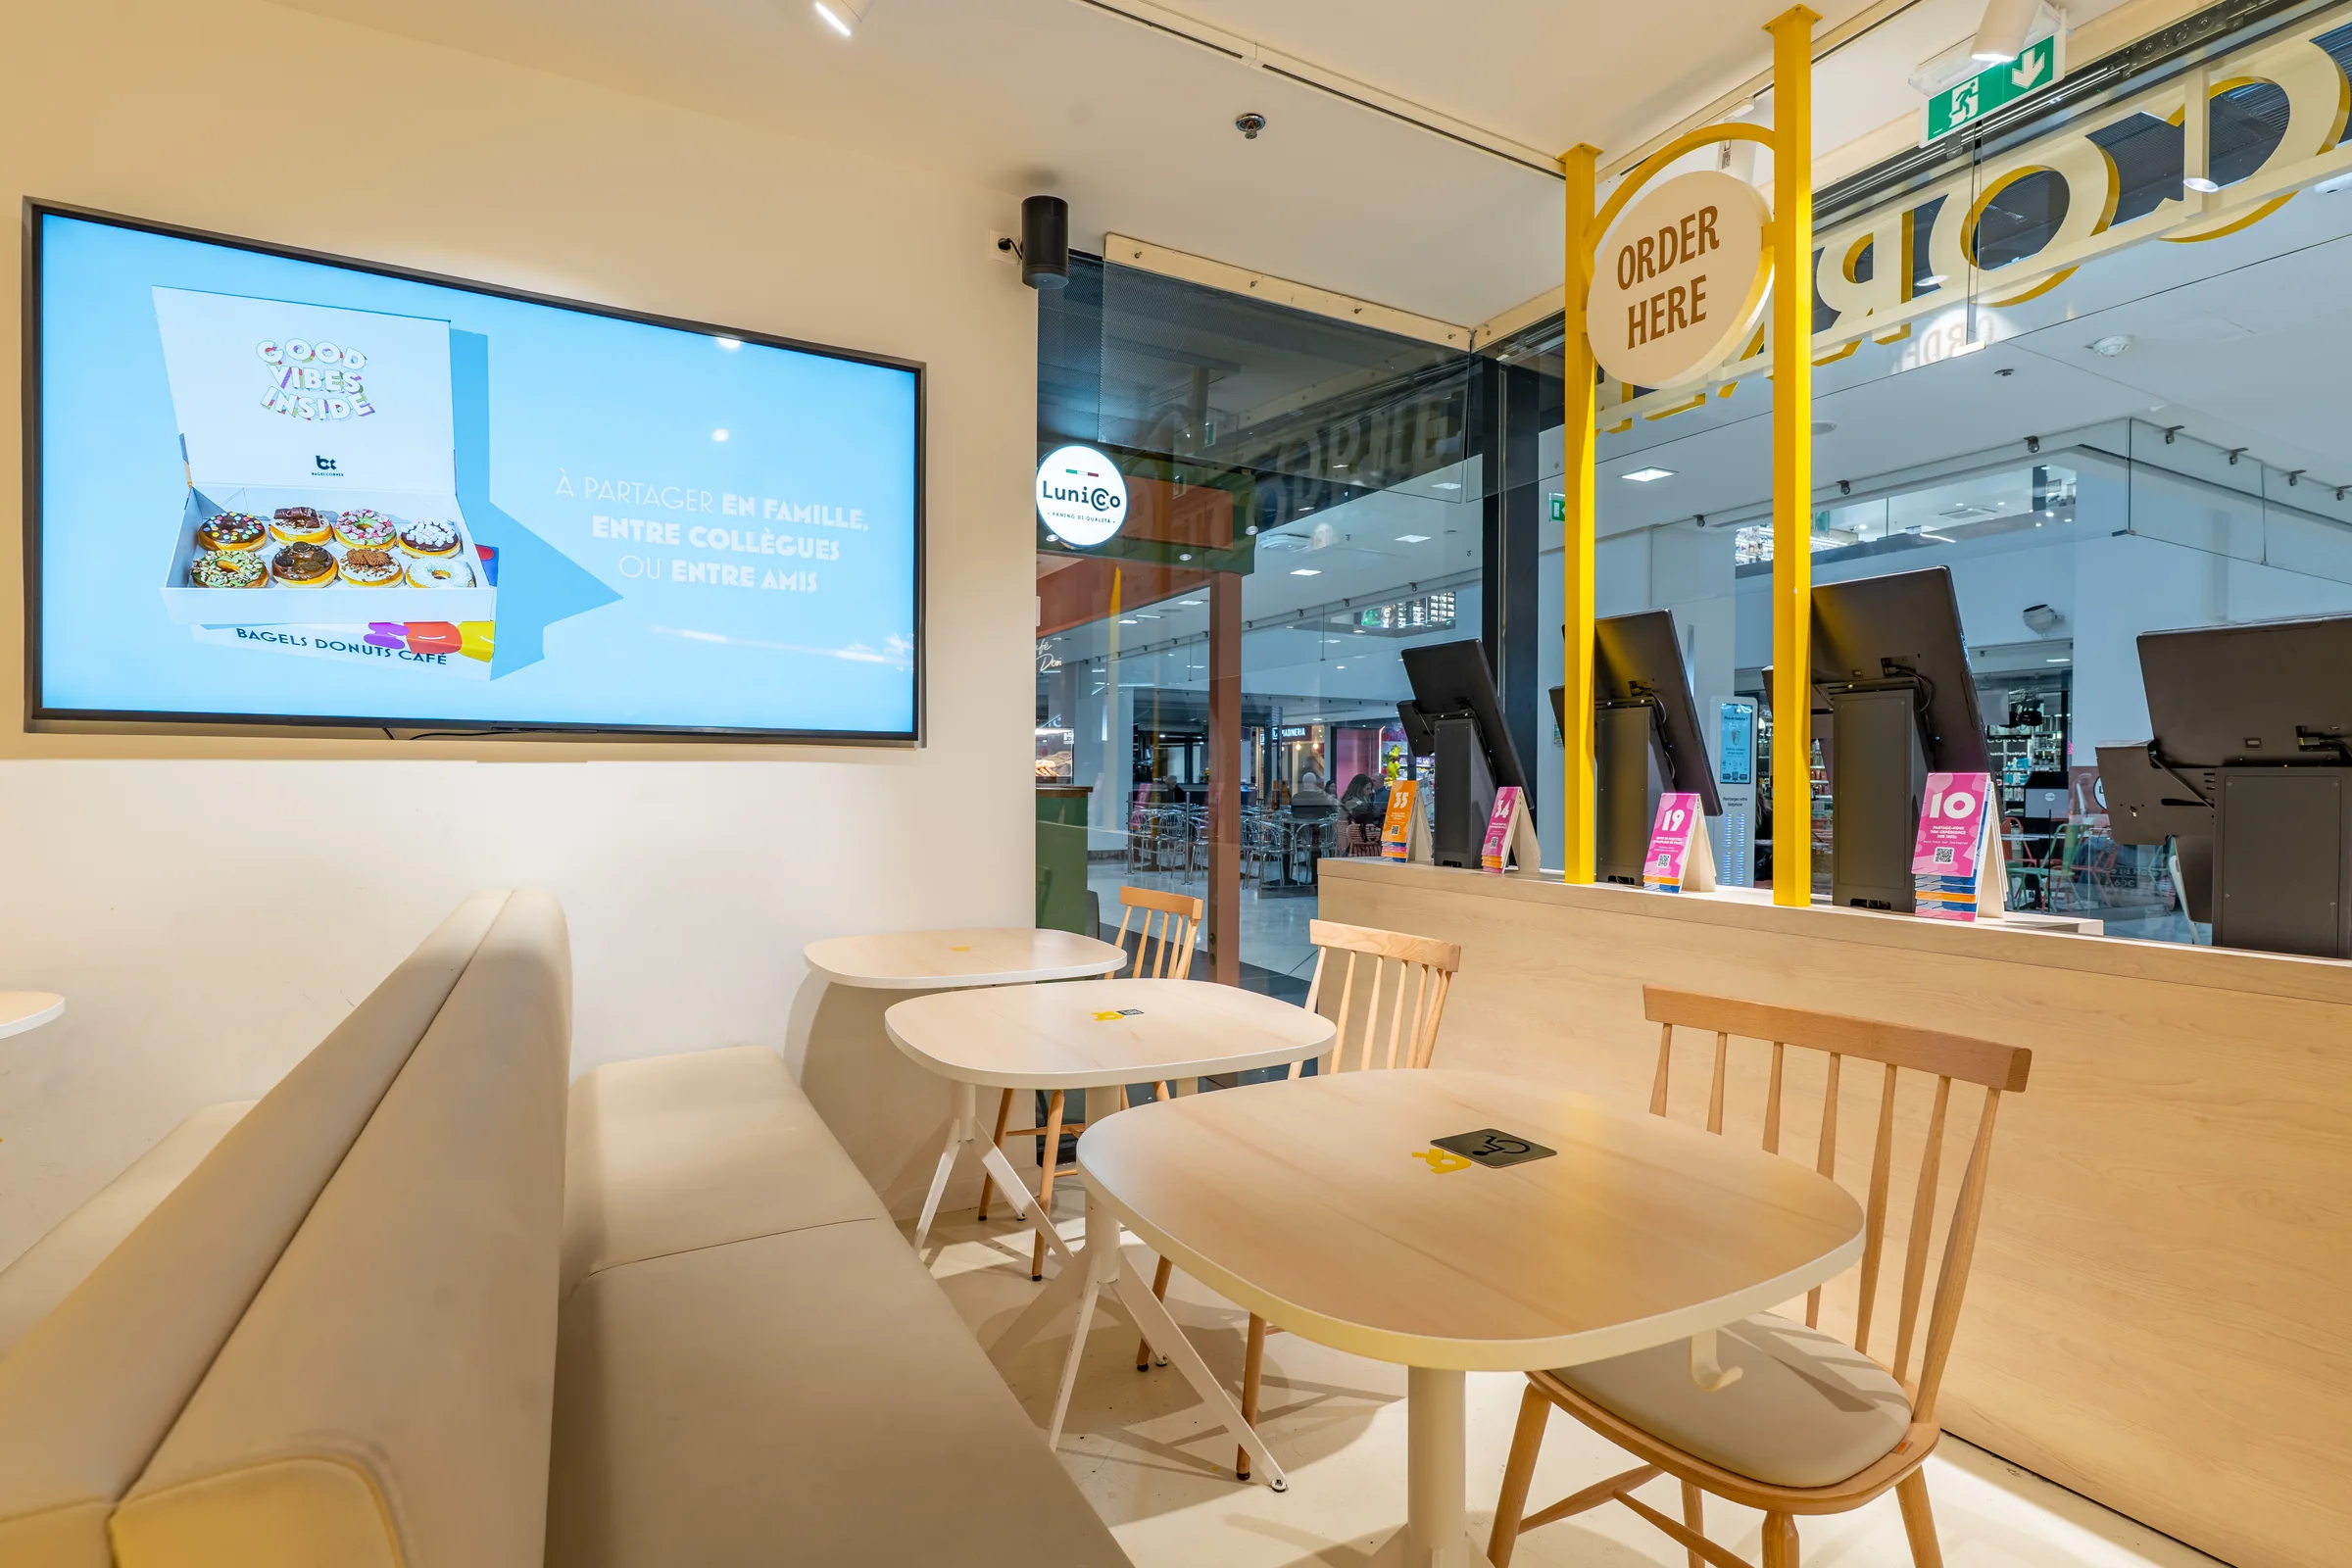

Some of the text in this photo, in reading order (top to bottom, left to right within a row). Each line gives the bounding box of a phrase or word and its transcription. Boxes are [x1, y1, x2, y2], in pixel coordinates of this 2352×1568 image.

[1617, 205, 1720, 291] ORDER
[1627, 273, 1707, 351] HERE
[256, 337, 368, 370] GOOD
[266, 364, 365, 395] VIBES
[260, 385, 376, 421] INSIDE
[555, 466, 869, 534] À PARTAGER EN FAMILLE,
[592, 514, 840, 562] ENTRE COLLÈGUES
[618, 554, 817, 593] OU ENTRE AMIS
[235, 627, 447, 665] BAGELS DONUTS CAFÉ
[1393, 792, 1409, 809] 35
[1494, 799, 1511, 818] 34
[1929, 791, 1976, 819] 10
[1661, 808, 1686, 832] 19
